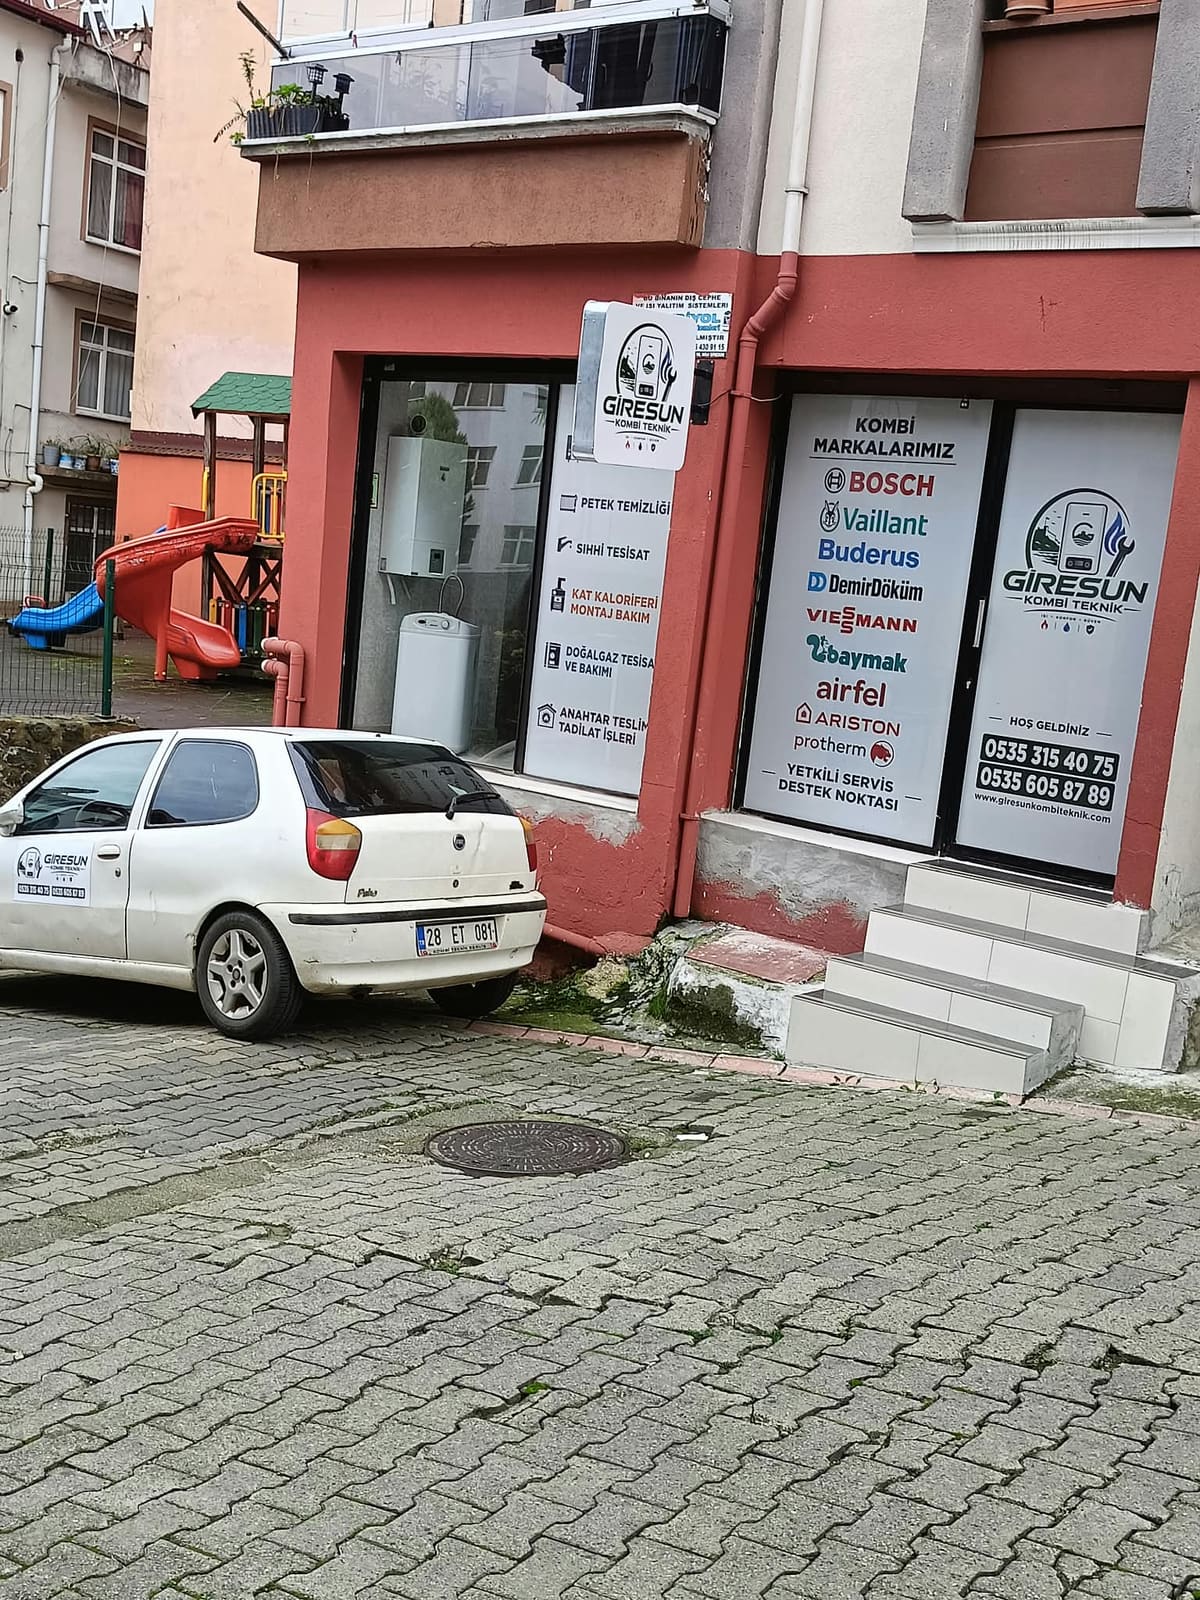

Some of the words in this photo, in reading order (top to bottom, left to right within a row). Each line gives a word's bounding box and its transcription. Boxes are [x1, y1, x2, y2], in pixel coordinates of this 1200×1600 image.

[684, 294, 696, 302] DIŞ
[696, 334, 724, 342] LMIŞTIR
[603, 395, 684, 424] GİRESUN
[615, 418, 641, 430] KOMBİ
[643, 422, 672, 434] TEKNİK
[856, 416, 915, 434] KOMBİ
[814, 438, 955, 459] MARKALARIMIZ
[849, 471, 935, 496] BOSCH
[580, 498, 614, 511] PETEK
[618, 499, 671, 516] TEMİZLİĞİ
[844, 508, 929, 536] Vaillant
[576, 543, 604, 556] SIHHİ
[606, 546, 650, 560] TESİSAT
[818, 538, 920, 568] Buderus
[572, 588, 592, 601] KAT
[594, 592, 659, 609] KALORİFERİ
[829, 574, 924, 602] DemirDöküm
[1003, 570, 1149, 604] GİRESUN
[570, 604, 613, 618] MONTAJ
[616, 609, 650, 624] BAKIM
[1024, 596, 1068, 608] KOMBİ
[1072, 600, 1124, 614] TEKNİK
[807, 606, 918, 634] VIESSMANN
[565, 661, 577, 672] VE
[580, 663, 612, 678] BAKIMI
[566, 646, 618, 664] DOĞALGAZ
[622, 654, 654, 669] TESİSA
[827, 644, 908, 673] baymak
[816, 677, 886, 707] airfel
[560, 707, 610, 726] ANAHTAR
[612, 716, 648, 732] TESLİM
[815, 712, 900, 736] ARISTON
[1010, 716, 1034, 730] HOŞ
[1036, 721, 1090, 737] GELDİNİZ
[558, 722, 602, 739] TADİLAT
[603, 727, 636, 745] İŞLERİ
[794, 736, 866, 757] protherm
[985, 738, 1028, 763] 0535
[1031, 746, 1060, 768] 315
[1064, 752, 1088, 772] 40
[1092, 755, 1115, 777] 75
[787, 762, 839, 784] YETKİLİ
[842, 773, 894, 792] SERVİS
[980, 766, 1022, 792] 0535
[1026, 774, 1060, 798] 605
[1062, 780, 1084, 802] 87
[1088, 784, 1111, 807] 89
[778, 778, 832, 799] DESTEK
[836, 789, 898, 812] NOKTASI
[974, 792, 1112, 824] www.giresunkombiteknik.com
[426, 928, 441, 946] 28
[452, 925, 465, 944] ET
[474, 922, 493, 941] 081
